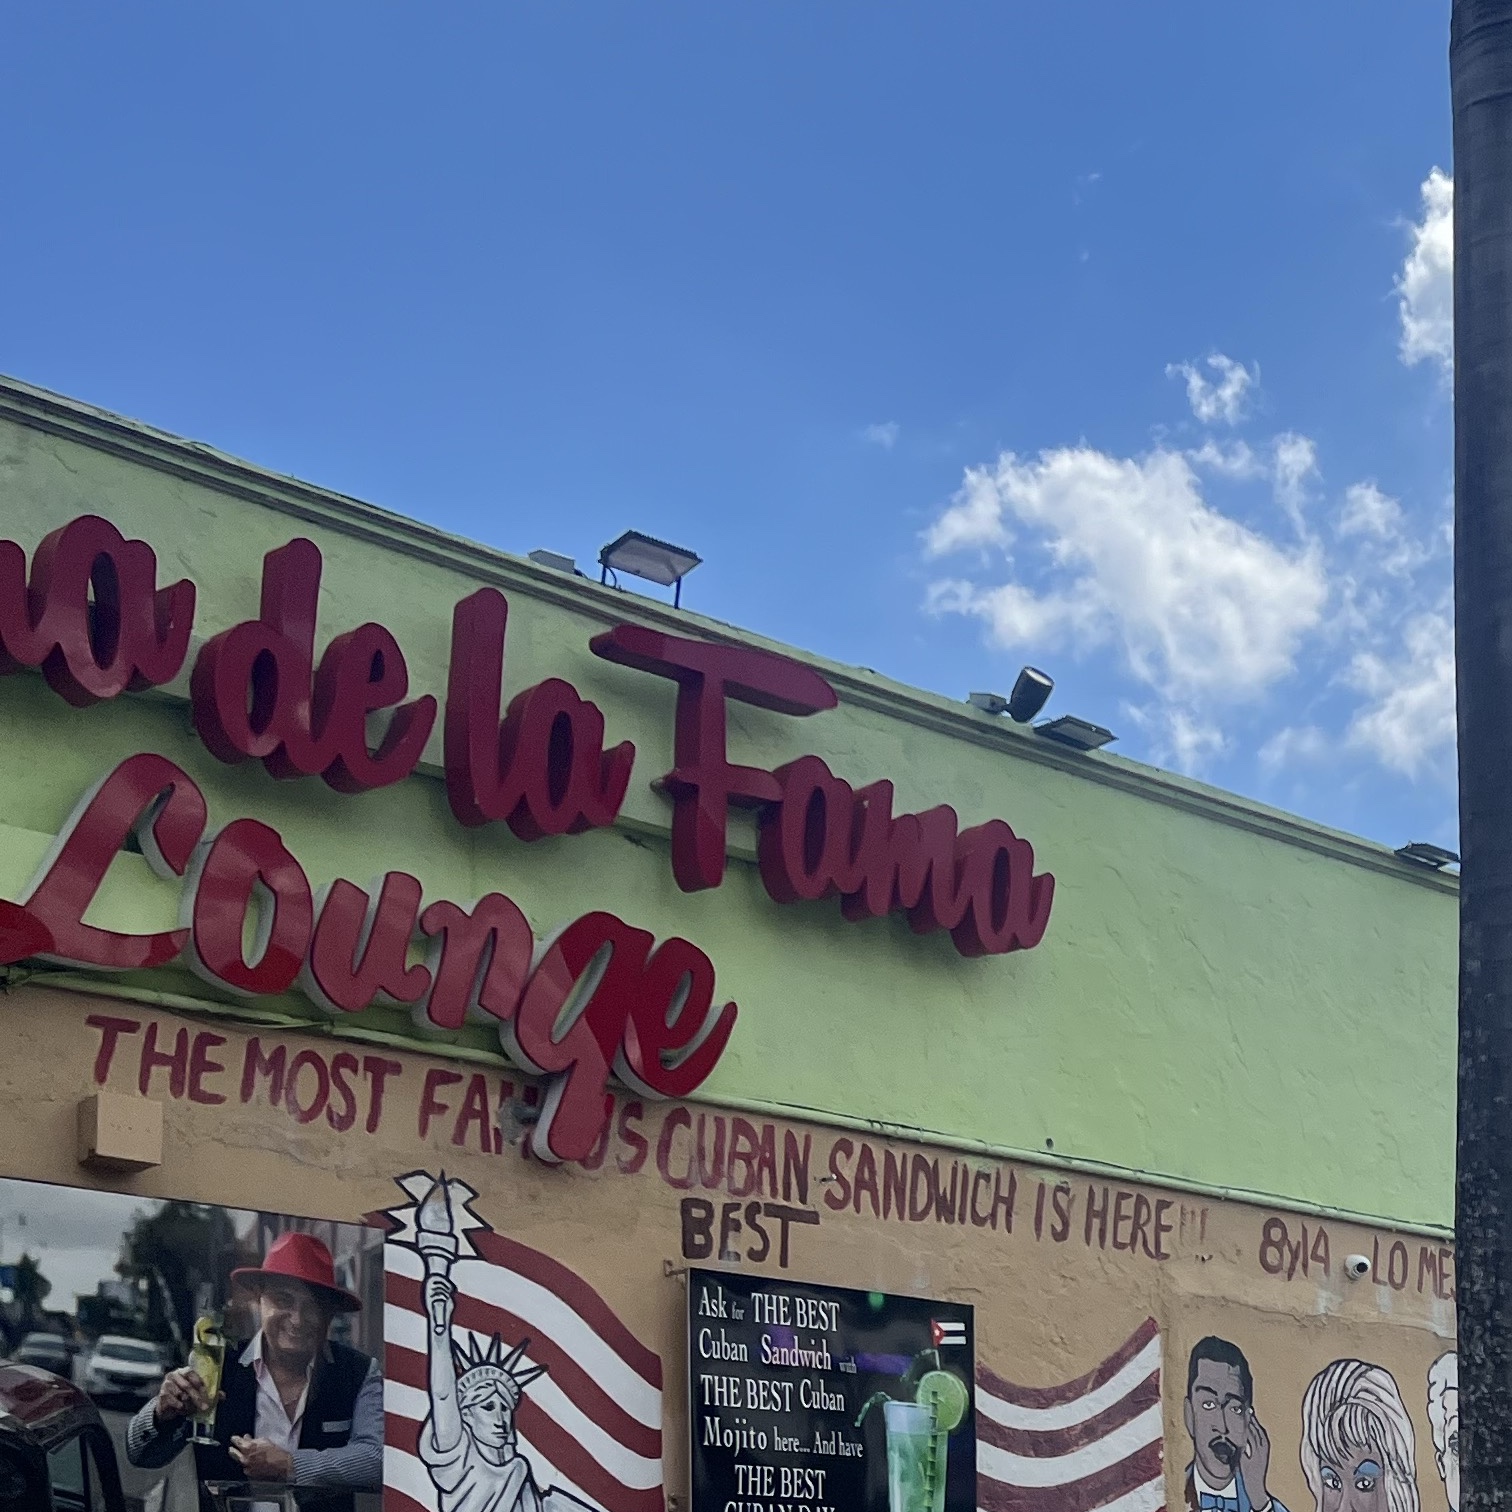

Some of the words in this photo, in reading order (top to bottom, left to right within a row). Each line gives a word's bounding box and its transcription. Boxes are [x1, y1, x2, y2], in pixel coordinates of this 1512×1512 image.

[190, 538, 437, 793] de
[444, 588, 636, 841] la
[589, 625, 1055, 957] Fama
[0, 753, 738, 1163] Lounge
[85, 1013, 227, 1105] THE
[240, 1036, 401, 1132] MOST
[656, 1106, 811, 1205] CUBAN
[824, 1138, 1017, 1235] SANDWICH
[1034, 1182, 1076, 1243] IS
[681, 1198, 820, 1268] BEST
[1370, 1234, 1408, 1292] LO
[1418, 1246, 1455, 1300] ME
[698, 1287, 727, 1318] Ask
[731, 1302, 744, 1320] for
[751, 1293, 792, 1326] THE
[795, 1298, 840, 1332] BEST
[700, 1328, 748, 1362] Cuban
[761, 1334, 831, 1370] Sandwich
[700, 1374, 742, 1408] THE
[745, 1379, 793, 1412] BEST
[800, 1379, 845, 1411] Cuban
[703, 1416, 768, 1457] Mojito
[813, 1431, 836, 1455] And
[838, 1432, 863, 1458] have
[735, 1465, 775, 1496] THE
[780, 1467, 826, 1499] BEST
